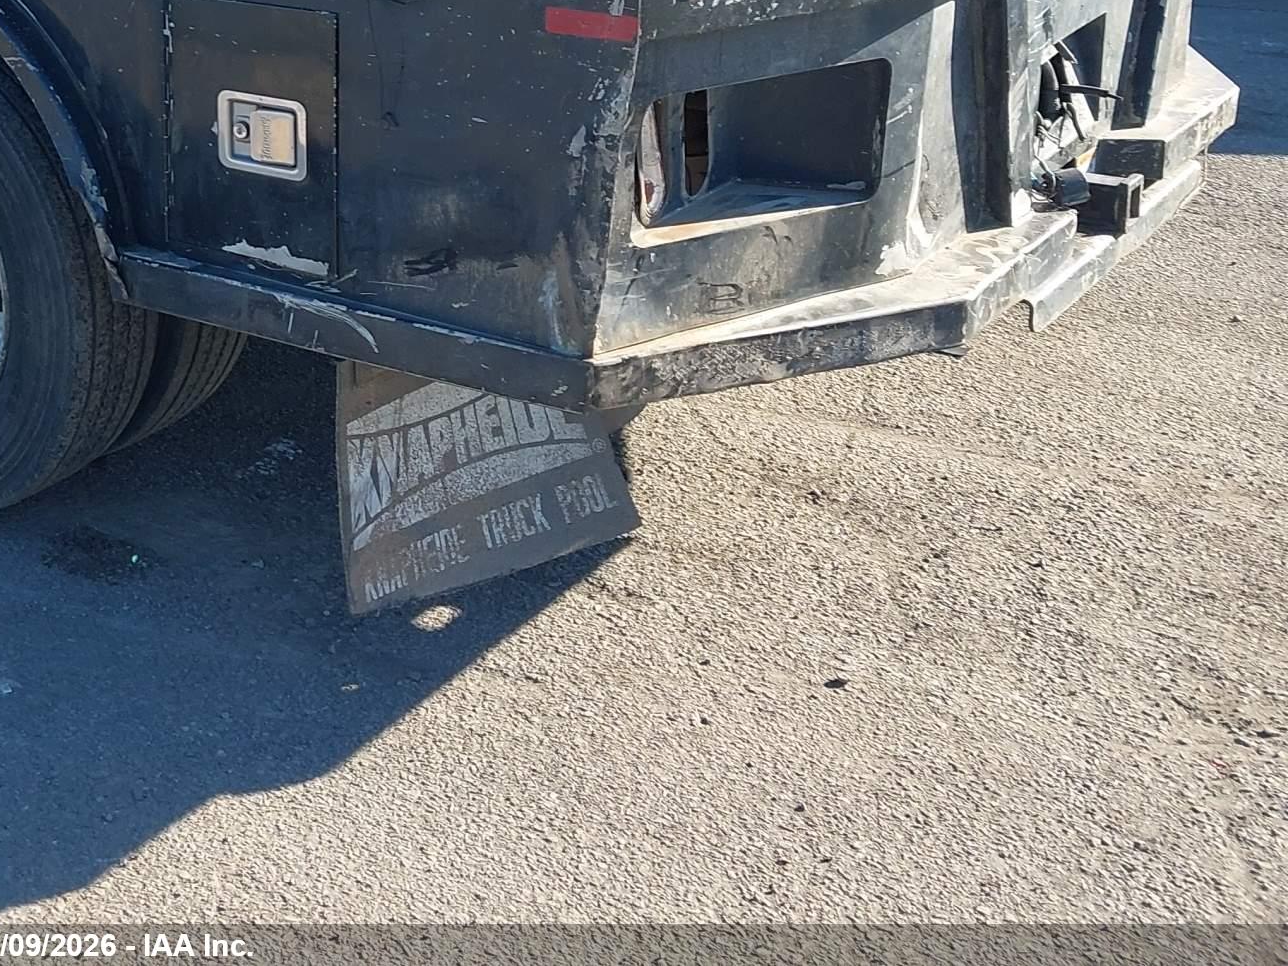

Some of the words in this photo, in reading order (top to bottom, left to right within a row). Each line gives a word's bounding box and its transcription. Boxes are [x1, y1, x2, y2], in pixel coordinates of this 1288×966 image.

[346, 395, 588, 532] KNAPHEIDE
[477, 493, 552, 550] TRUCK
[555, 472, 618, 525] POOL
